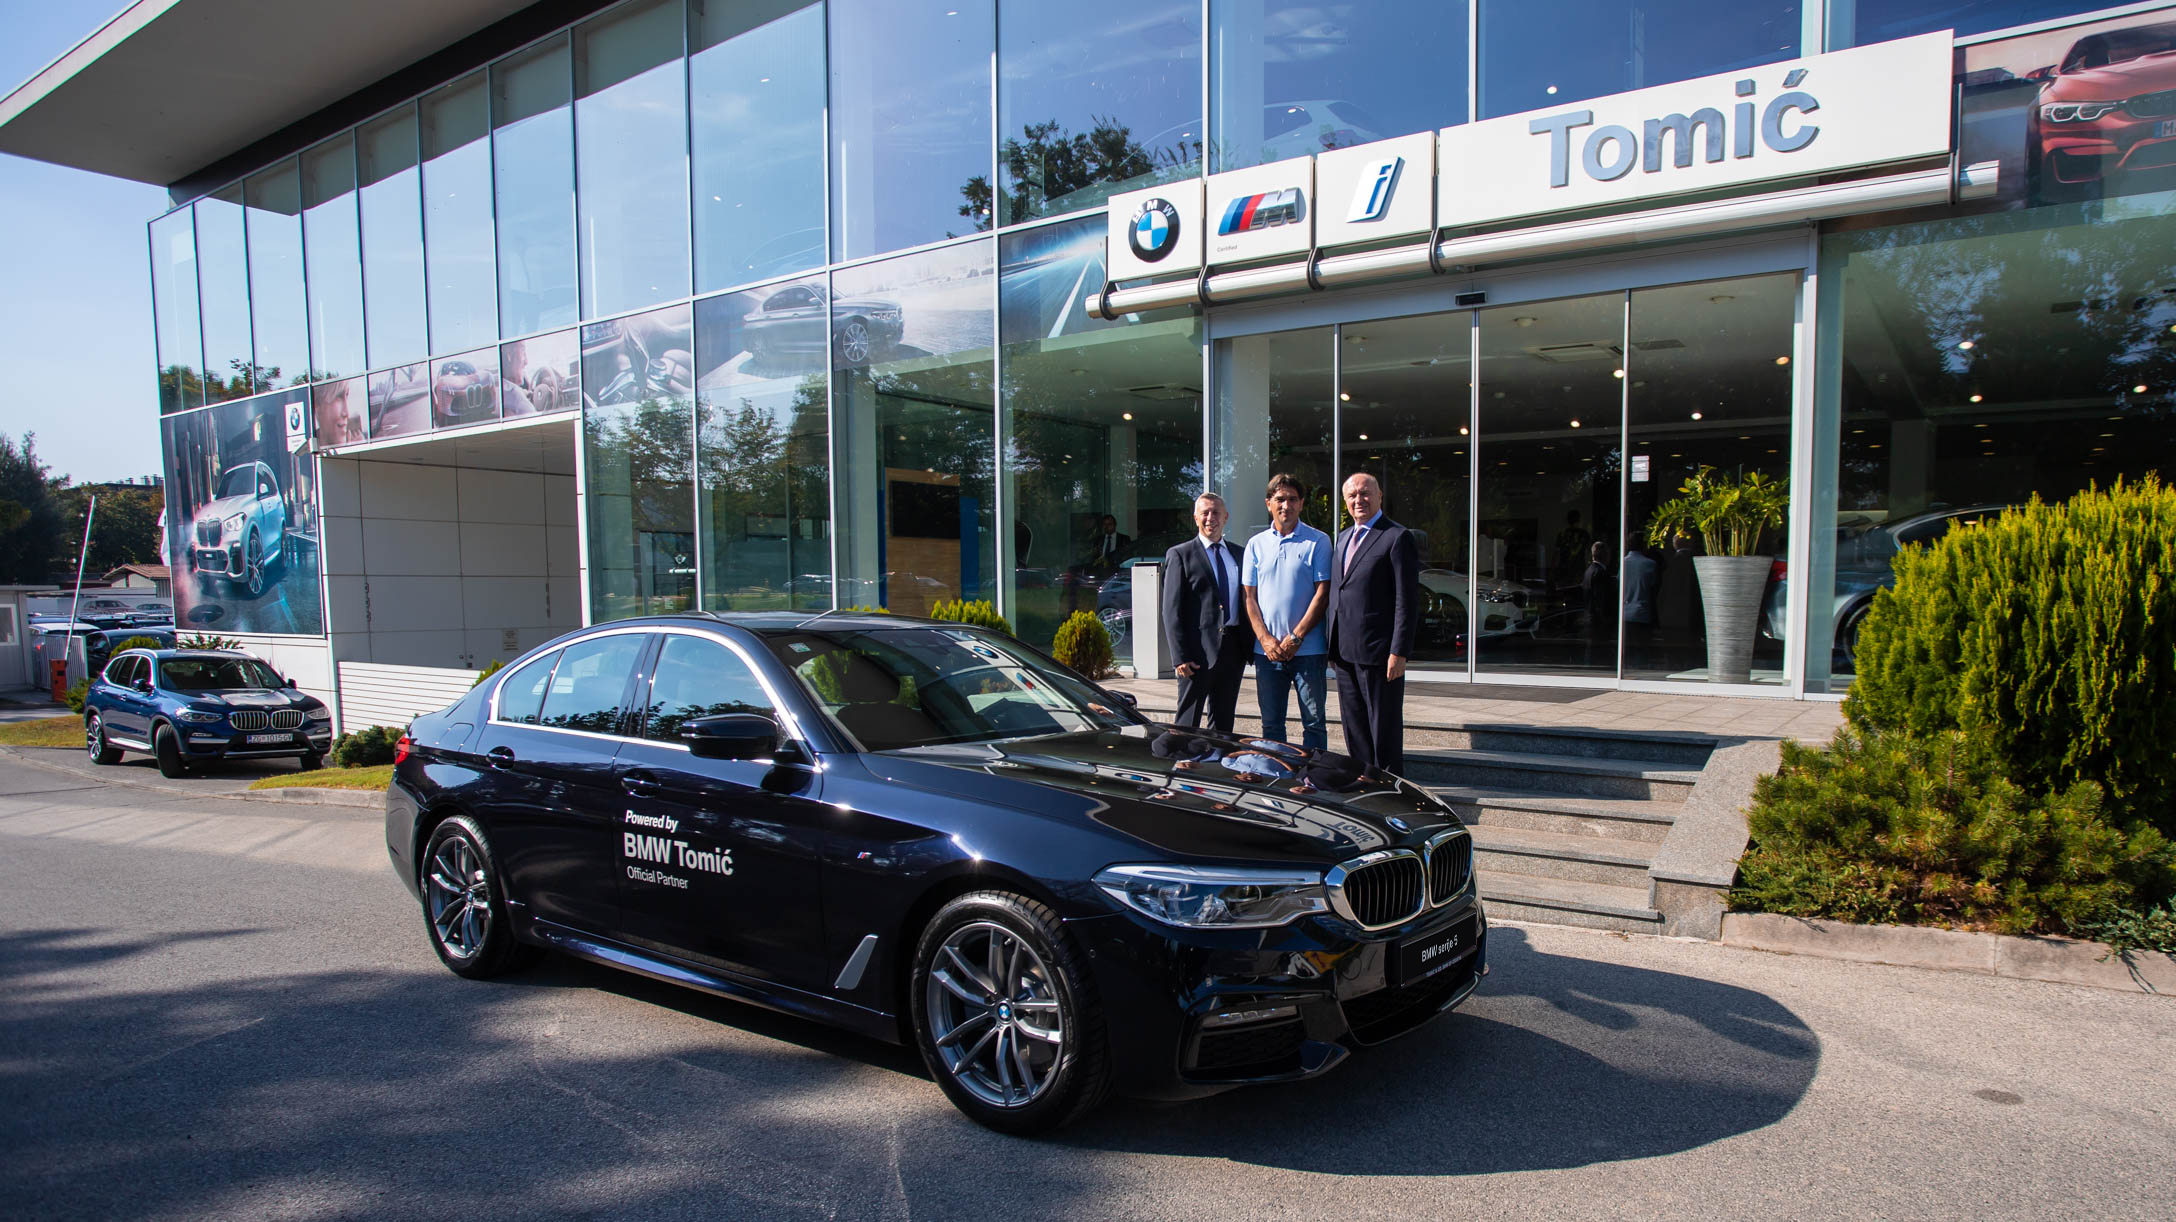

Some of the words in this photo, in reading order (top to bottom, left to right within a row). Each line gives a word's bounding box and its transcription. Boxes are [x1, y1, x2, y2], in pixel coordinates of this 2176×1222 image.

[1529, 68, 1820, 189] Tomić
[1131, 198, 1175, 224] BMW
[625, 809, 665, 829] Powered
[665, 815, 679, 833] by
[624, 832, 671, 864] BMW
[674, 840, 734, 876] Tomić
[626, 865, 656, 883] Official
[656, 871, 689, 889] Partner
[1421, 944, 1438, 962] BMW
[1438, 938, 1454, 954] serije
[1453, 934, 1458, 947] 5
